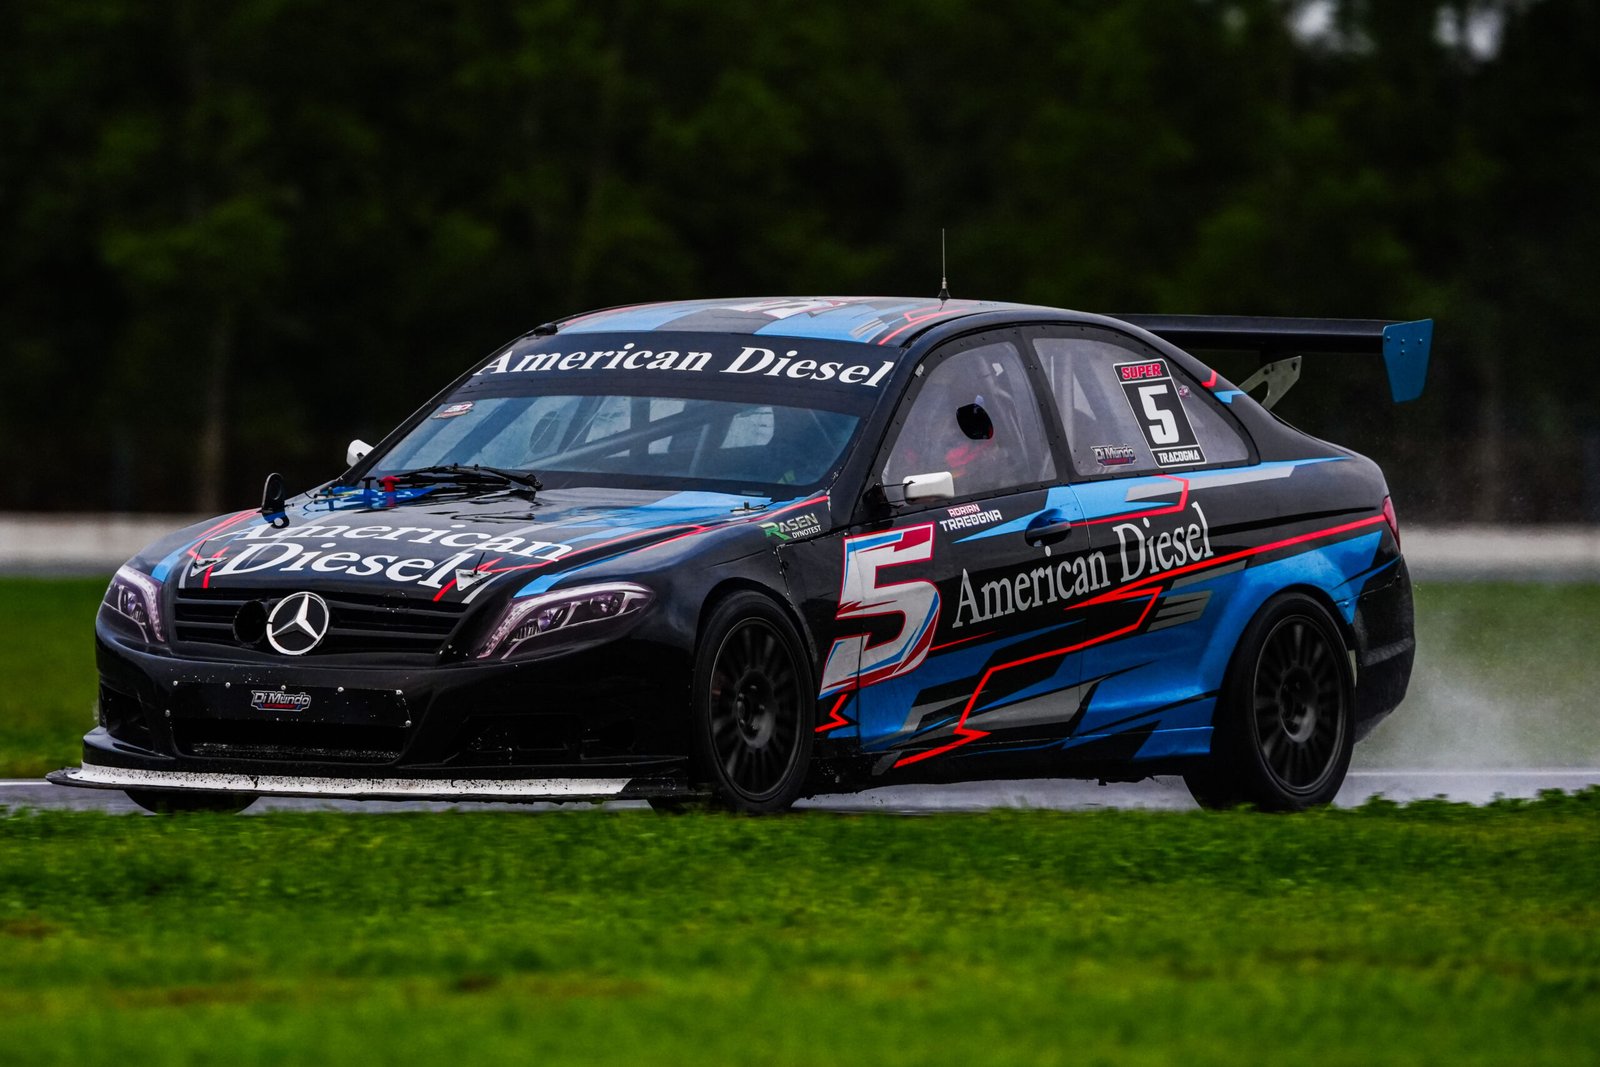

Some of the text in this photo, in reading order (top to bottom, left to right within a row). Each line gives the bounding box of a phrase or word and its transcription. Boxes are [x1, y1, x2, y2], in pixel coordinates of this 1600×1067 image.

[473, 343, 895, 388] American Diesel
[1121, 363, 1162, 380] SUPER
[1138, 384, 1180, 444] 5
[1158, 449, 1200, 464] TRACOGNA
[758, 512, 819, 541] RASEN
[947, 503, 980, 517] ADRIAN
[205, 523, 573, 562] American
[791, 524, 821, 539] DYNOTEST
[210, 542, 475, 589] Diesel
[950, 501, 1214, 628] American Diesel
[817, 521, 943, 700] 5
[254, 692, 309, 705] Di Mundo
